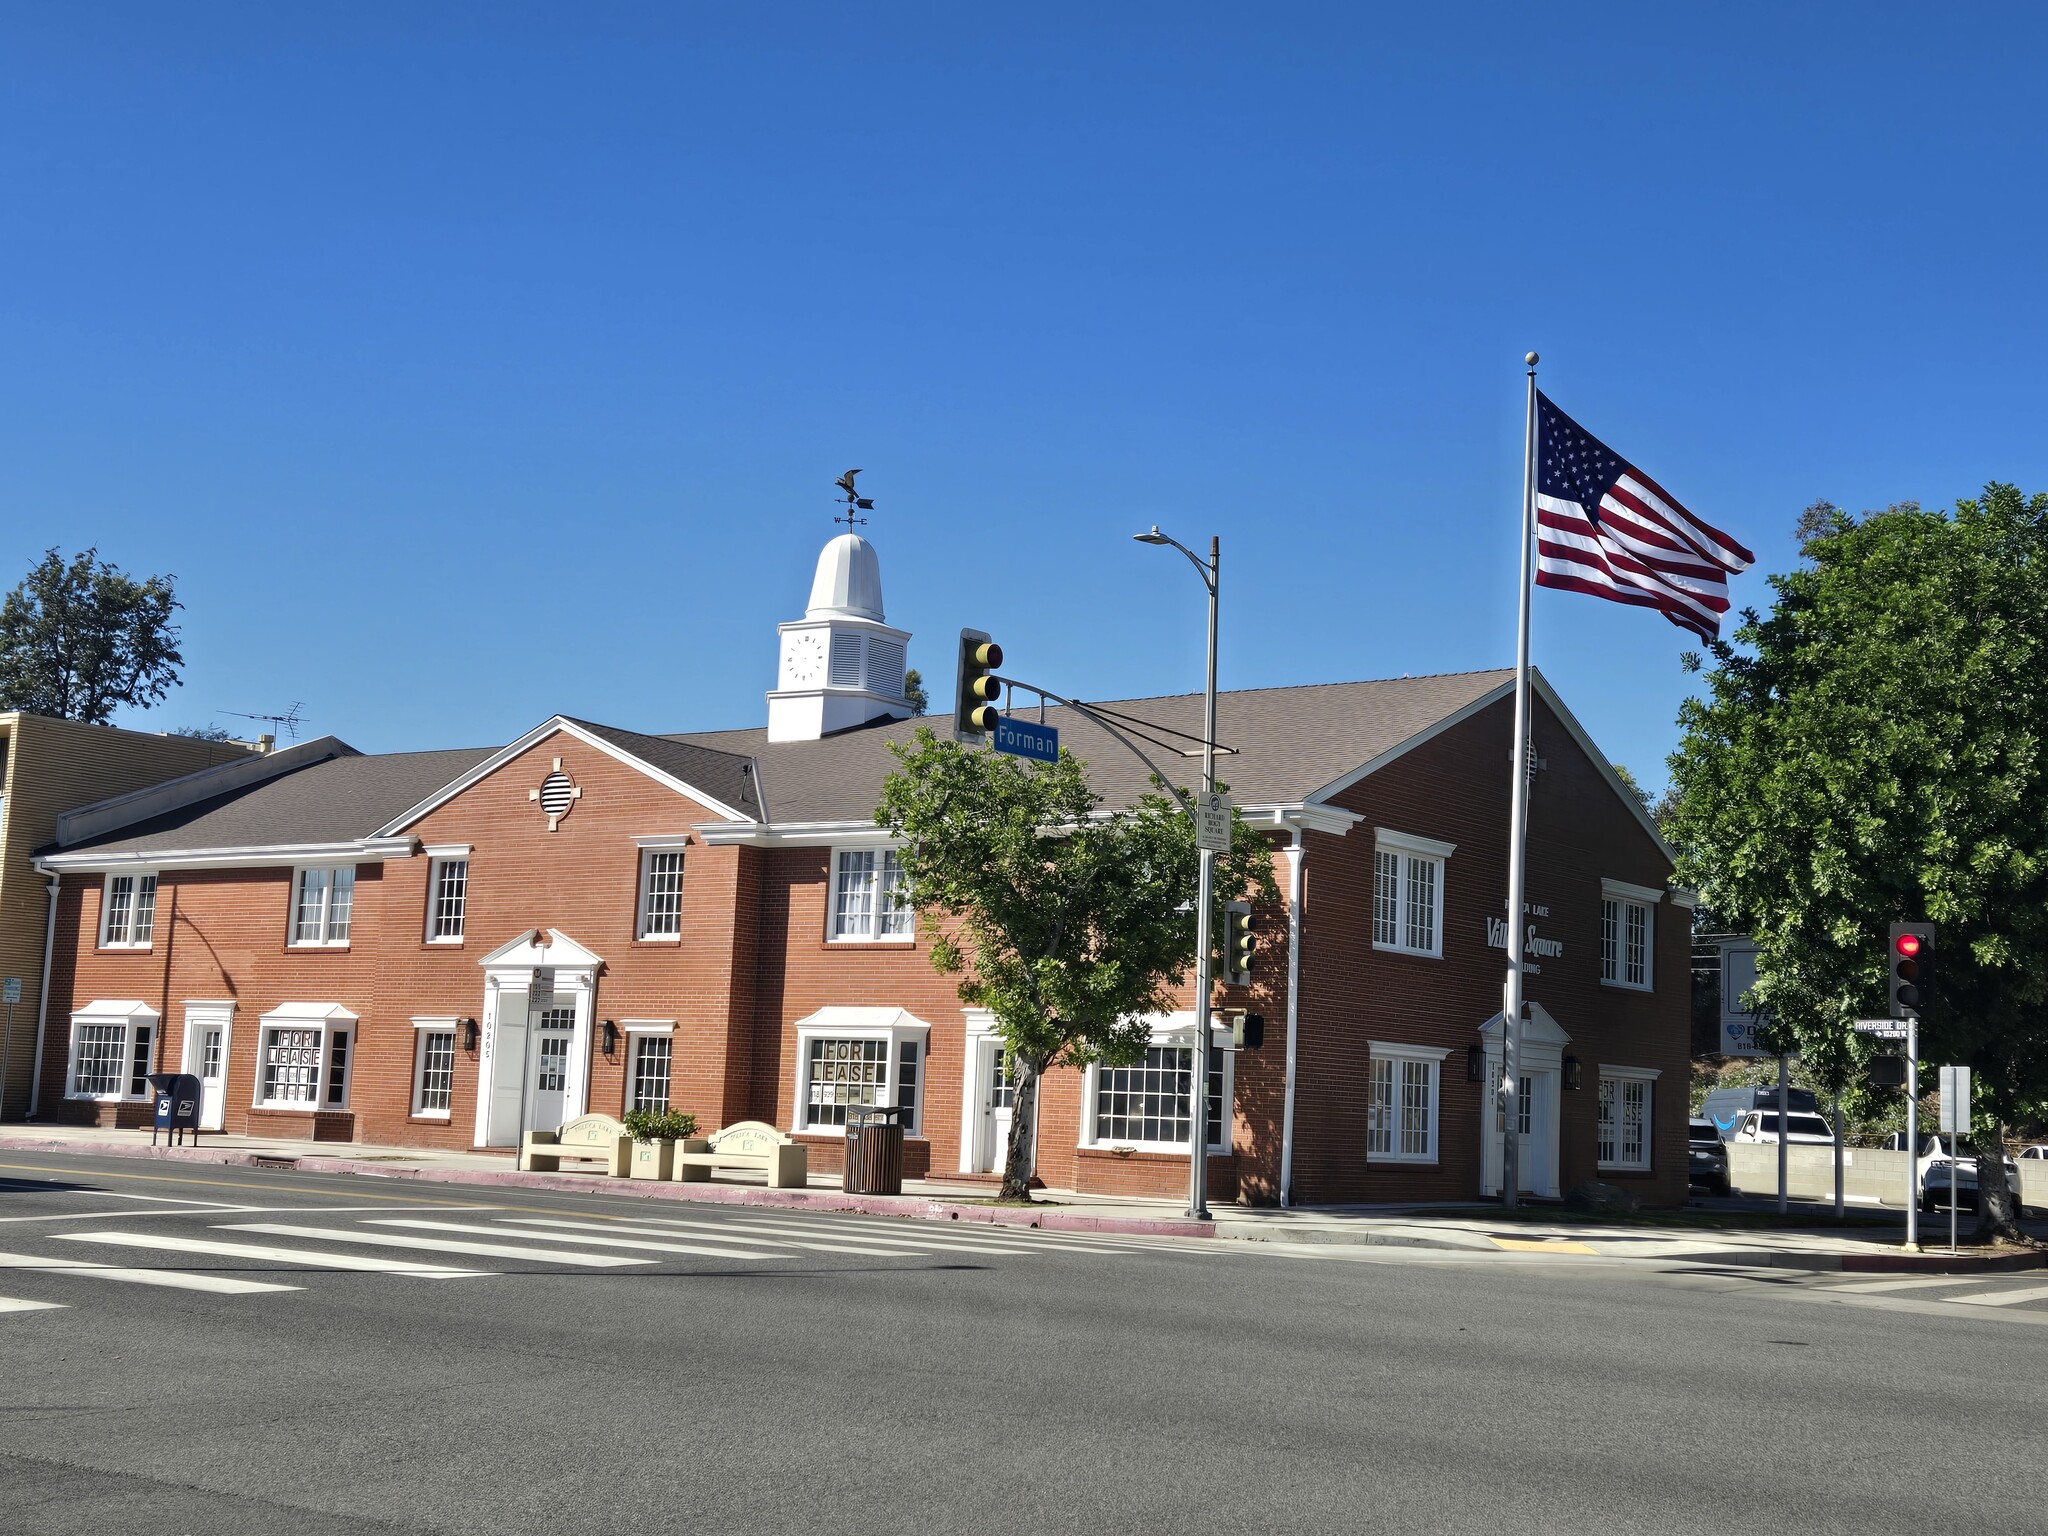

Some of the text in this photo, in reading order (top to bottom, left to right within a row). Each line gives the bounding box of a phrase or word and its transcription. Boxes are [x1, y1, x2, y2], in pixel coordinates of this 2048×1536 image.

[999, 725, 1054, 754] Forman
[1204, 812, 1226, 821] RICHARD
[1205, 826, 1224, 835] SQUARE
[1533, 905, 1550, 917] LAKE
[1486, 916, 1563, 958] Vill Square
[1855, 1021, 1894, 1030] RIVERSIDE
[281, 1031, 312, 1047] FOR
[485, 1012, 493, 1059] 10205
[1883, 1030, 1900, 1038] 10200
[267, 1049, 320, 1066] LEASE
[826, 1043, 862, 1060] FOR
[812, 1063, 874, 1083] LEASE
